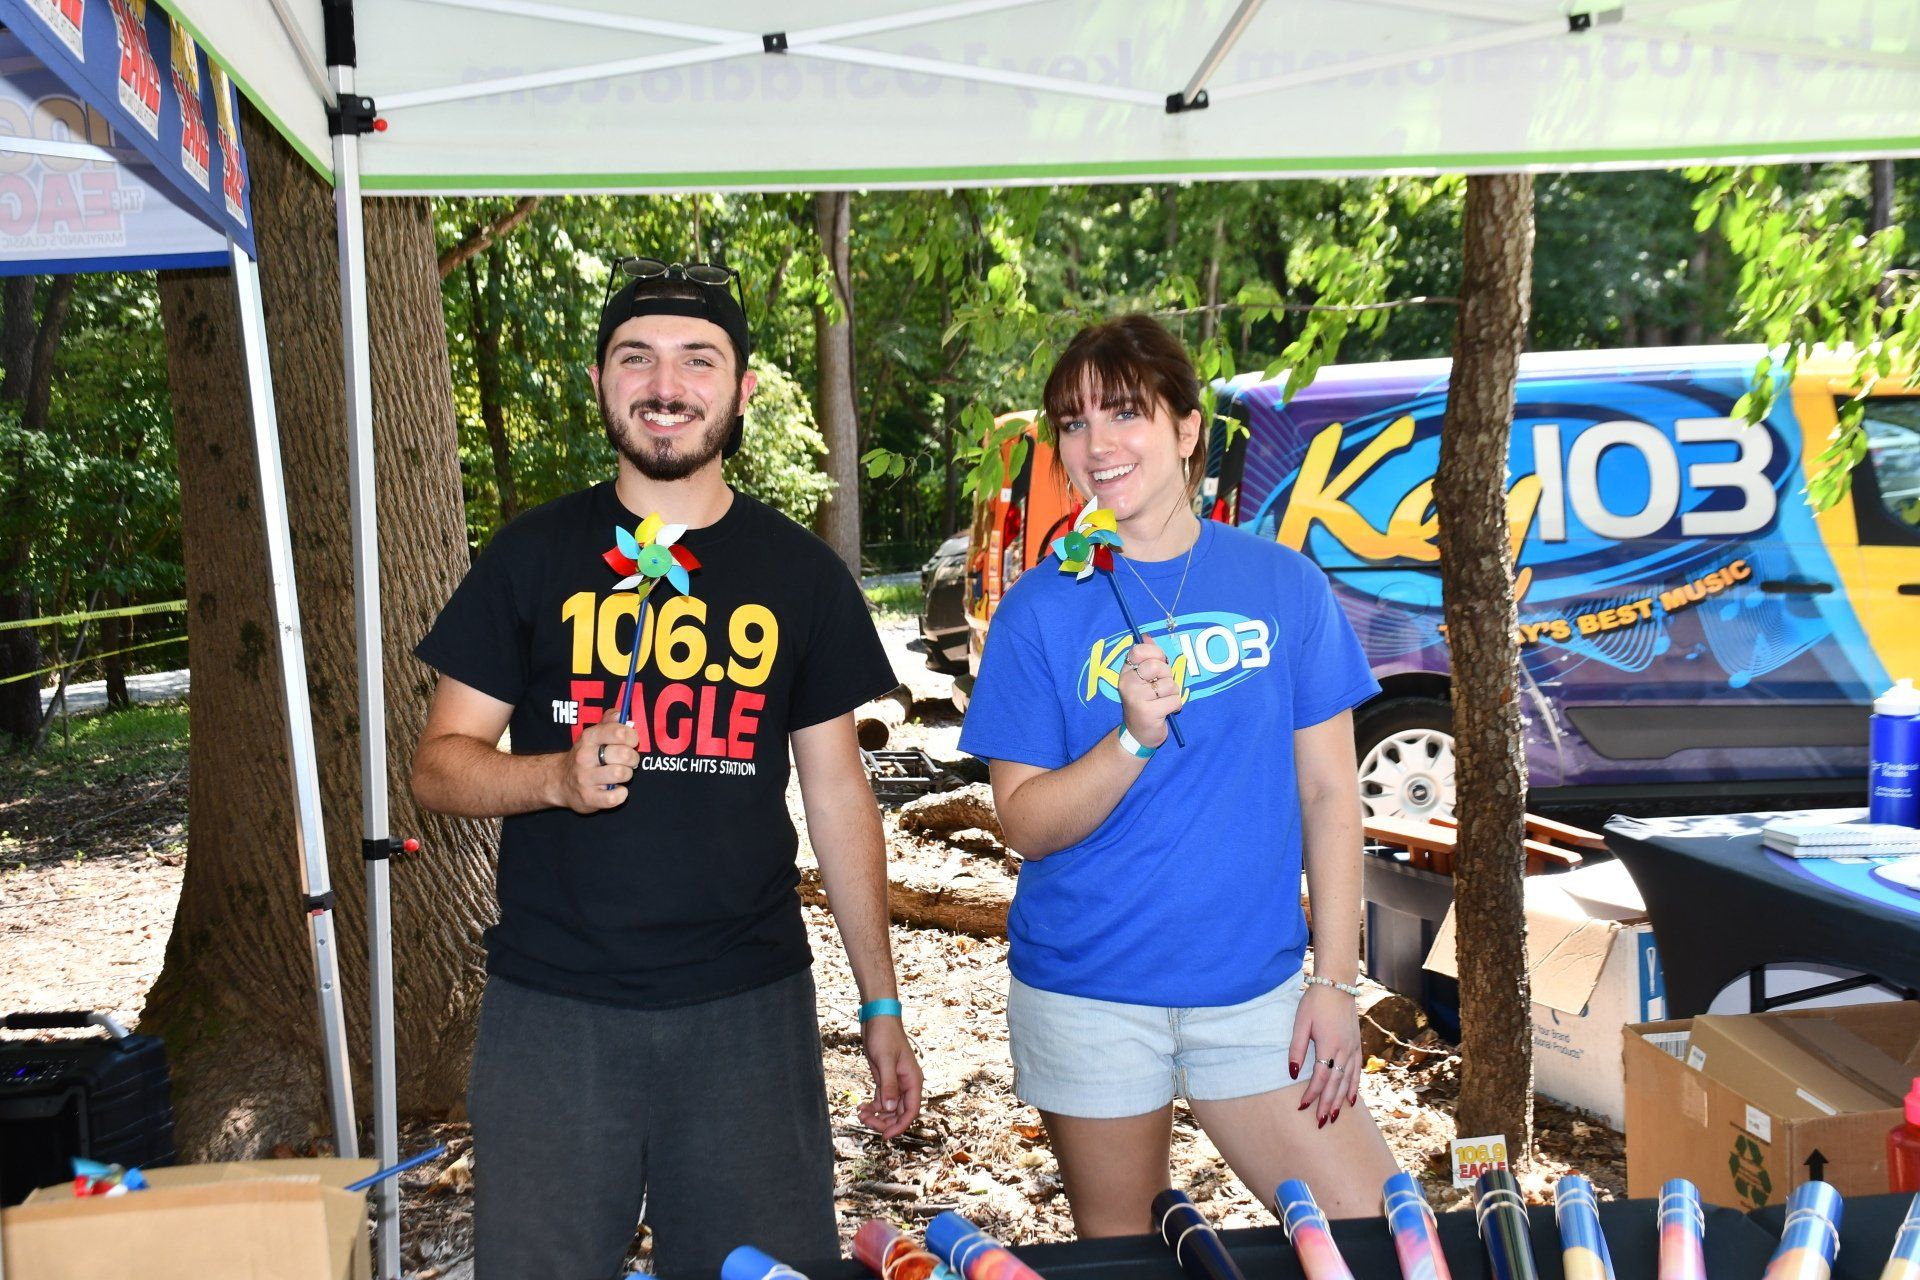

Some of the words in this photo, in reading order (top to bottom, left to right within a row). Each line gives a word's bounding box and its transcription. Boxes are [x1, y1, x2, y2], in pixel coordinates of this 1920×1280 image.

[1577, 597, 1653, 635] BEST
[1659, 559, 1752, 612] MUSIC
[561, 591, 779, 687] 106.9
[1179, 619, 1271, 678] 103
[552, 699, 578, 724] THE
[642, 756, 688, 772] CLASSIC
[690, 758, 717, 774] HITS
[719, 760, 756, 776] STATION
[1455, 1143, 1506, 1164] 106.9
